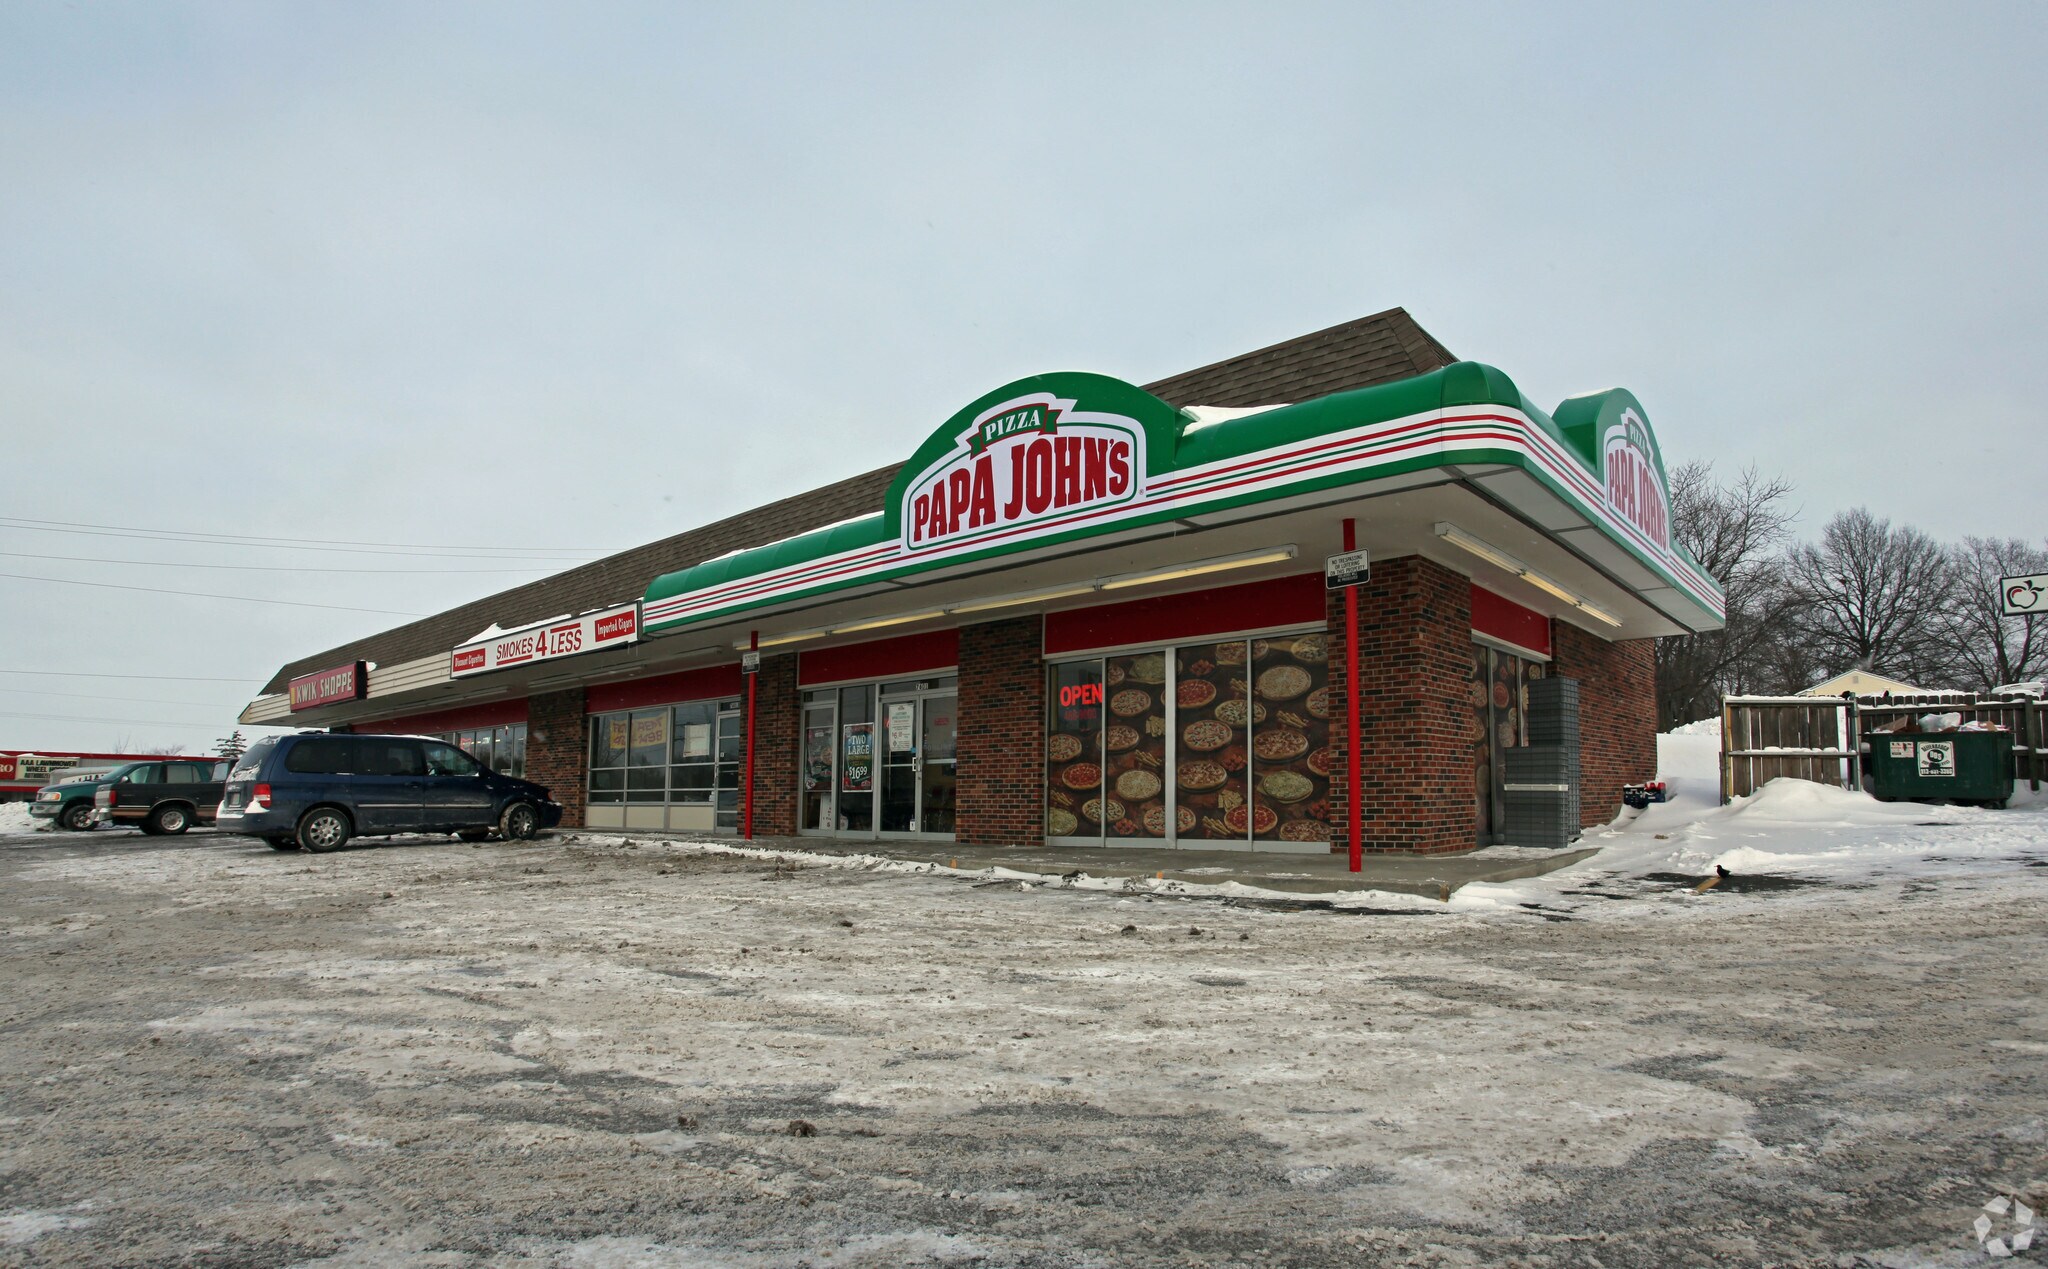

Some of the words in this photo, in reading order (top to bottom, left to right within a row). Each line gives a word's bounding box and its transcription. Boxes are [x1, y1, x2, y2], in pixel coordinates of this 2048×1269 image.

[985, 410, 1041, 441] PIZZA
[1629, 423, 1647, 455] PIZZA
[914, 454, 997, 542] PAPA
[1004, 437, 1130, 520] JOHN'S
[1608, 448, 1637, 525] PAPA
[597, 618, 618, 638] Imported
[618, 617, 633, 633] Cigars
[496, 637, 533, 660] SMOKES
[536, 630, 547, 656] 4
[551, 629, 582, 655] LESS
[296, 681, 317, 704] KWIK
[320, 671, 353, 698] SHOPPE
[1060, 682, 1102, 707] OPEN
[848, 744, 870, 755] LARGE
[851, 734, 867, 745] TWO
